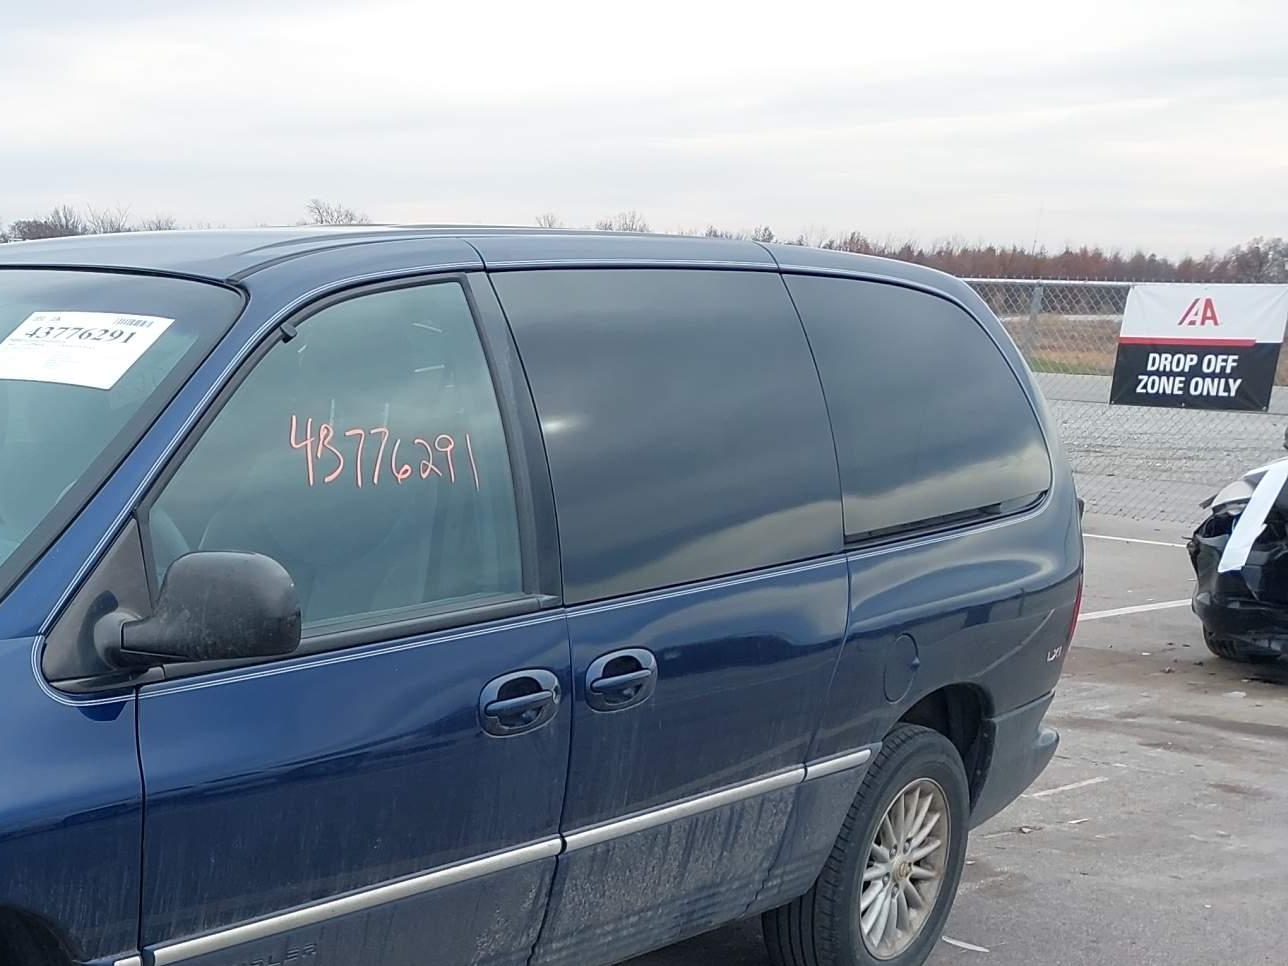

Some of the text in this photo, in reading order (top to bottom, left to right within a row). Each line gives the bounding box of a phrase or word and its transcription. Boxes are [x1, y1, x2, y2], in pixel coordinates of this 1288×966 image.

[25, 326, 136, 344] 43776291
[1146, 353, 1239, 374] DROP OFF
[1136, 375, 1242, 397] ZONE ONLY
[290, 415, 480, 492] 43776291
